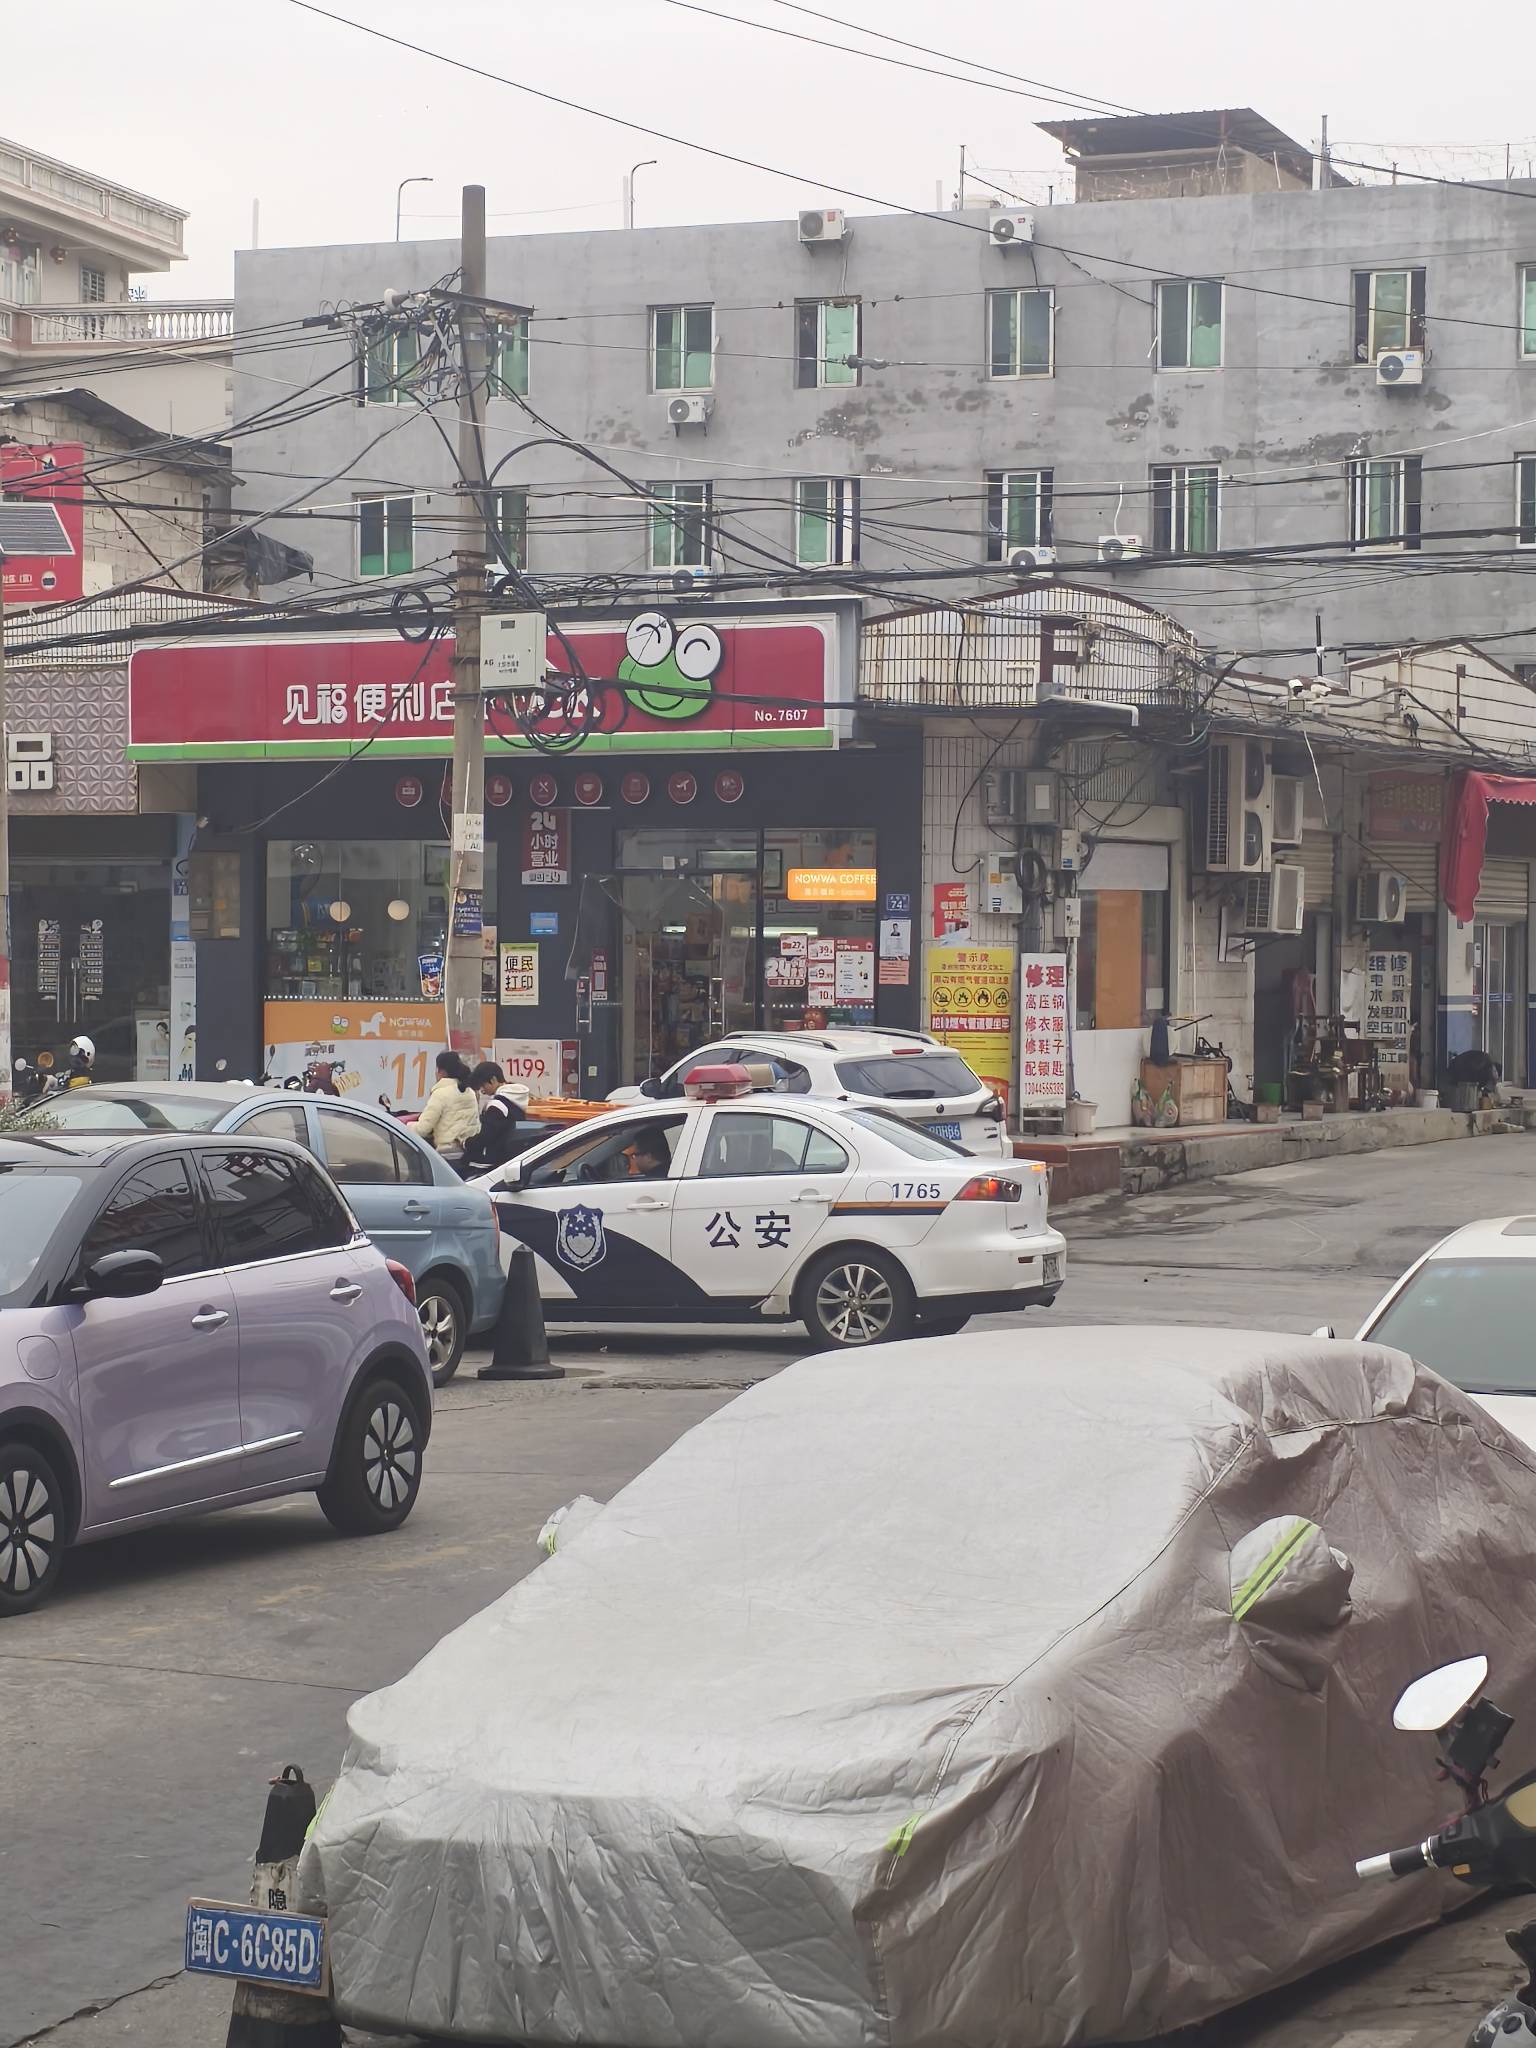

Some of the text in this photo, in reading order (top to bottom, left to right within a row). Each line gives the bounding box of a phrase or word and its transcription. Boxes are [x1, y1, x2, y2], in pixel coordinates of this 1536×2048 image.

[283, 680, 456, 725] 见福便利店
[754, 709, 808, 722] No.7607
[8, 733, 53, 790] 品
[531, 834, 559, 850] 小时
[531, 850, 559, 867] 营业
[794, 873, 877, 884] NOWWA COFFEE
[505, 955, 534, 971] 便民
[1369, 955, 1407, 971] 维修
[505, 975, 534, 990] 打印
[1025, 964, 1065, 988] 修理
[1370, 974, 1405, 987] 电机
[1025, 994, 1065, 1009] 高压锅
[1370, 990, 1404, 1003] 水泵
[1368, 1006, 1407, 1020] 发电机
[1025, 1016, 1065, 1032] 修衣服
[1367, 1021, 1407, 1035] 空压机
[1025, 1039, 1065, 1055] 修鞋子
[1377, 1052, 1408, 1064] 动工具
[506, 1057, 545, 1078] 11.99
[1025, 1061, 1065, 1077] 配锁匙
[892, 1183, 941, 1199] 1765
[705, 1210, 791, 1249] 公安
